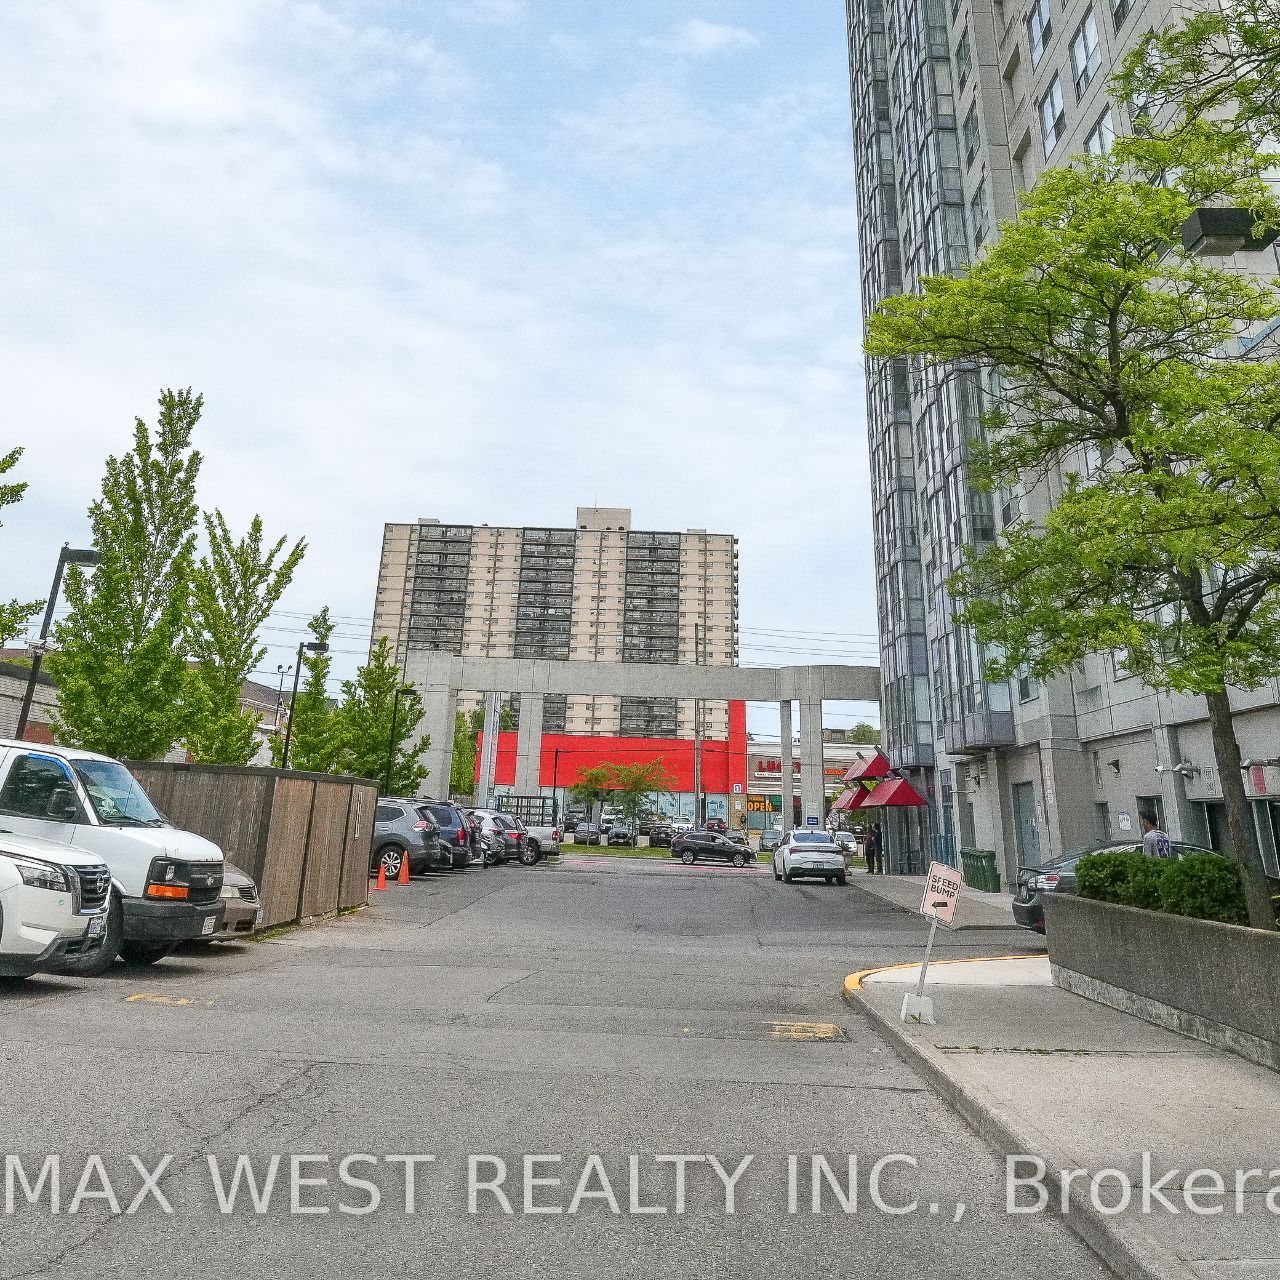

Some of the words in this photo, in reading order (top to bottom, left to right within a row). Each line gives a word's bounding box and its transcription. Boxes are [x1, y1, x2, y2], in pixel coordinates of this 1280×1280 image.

[747, 802, 773, 811] OPEN
[931, 874, 959, 890] SPEED
[931, 884, 955, 898] BUMP
